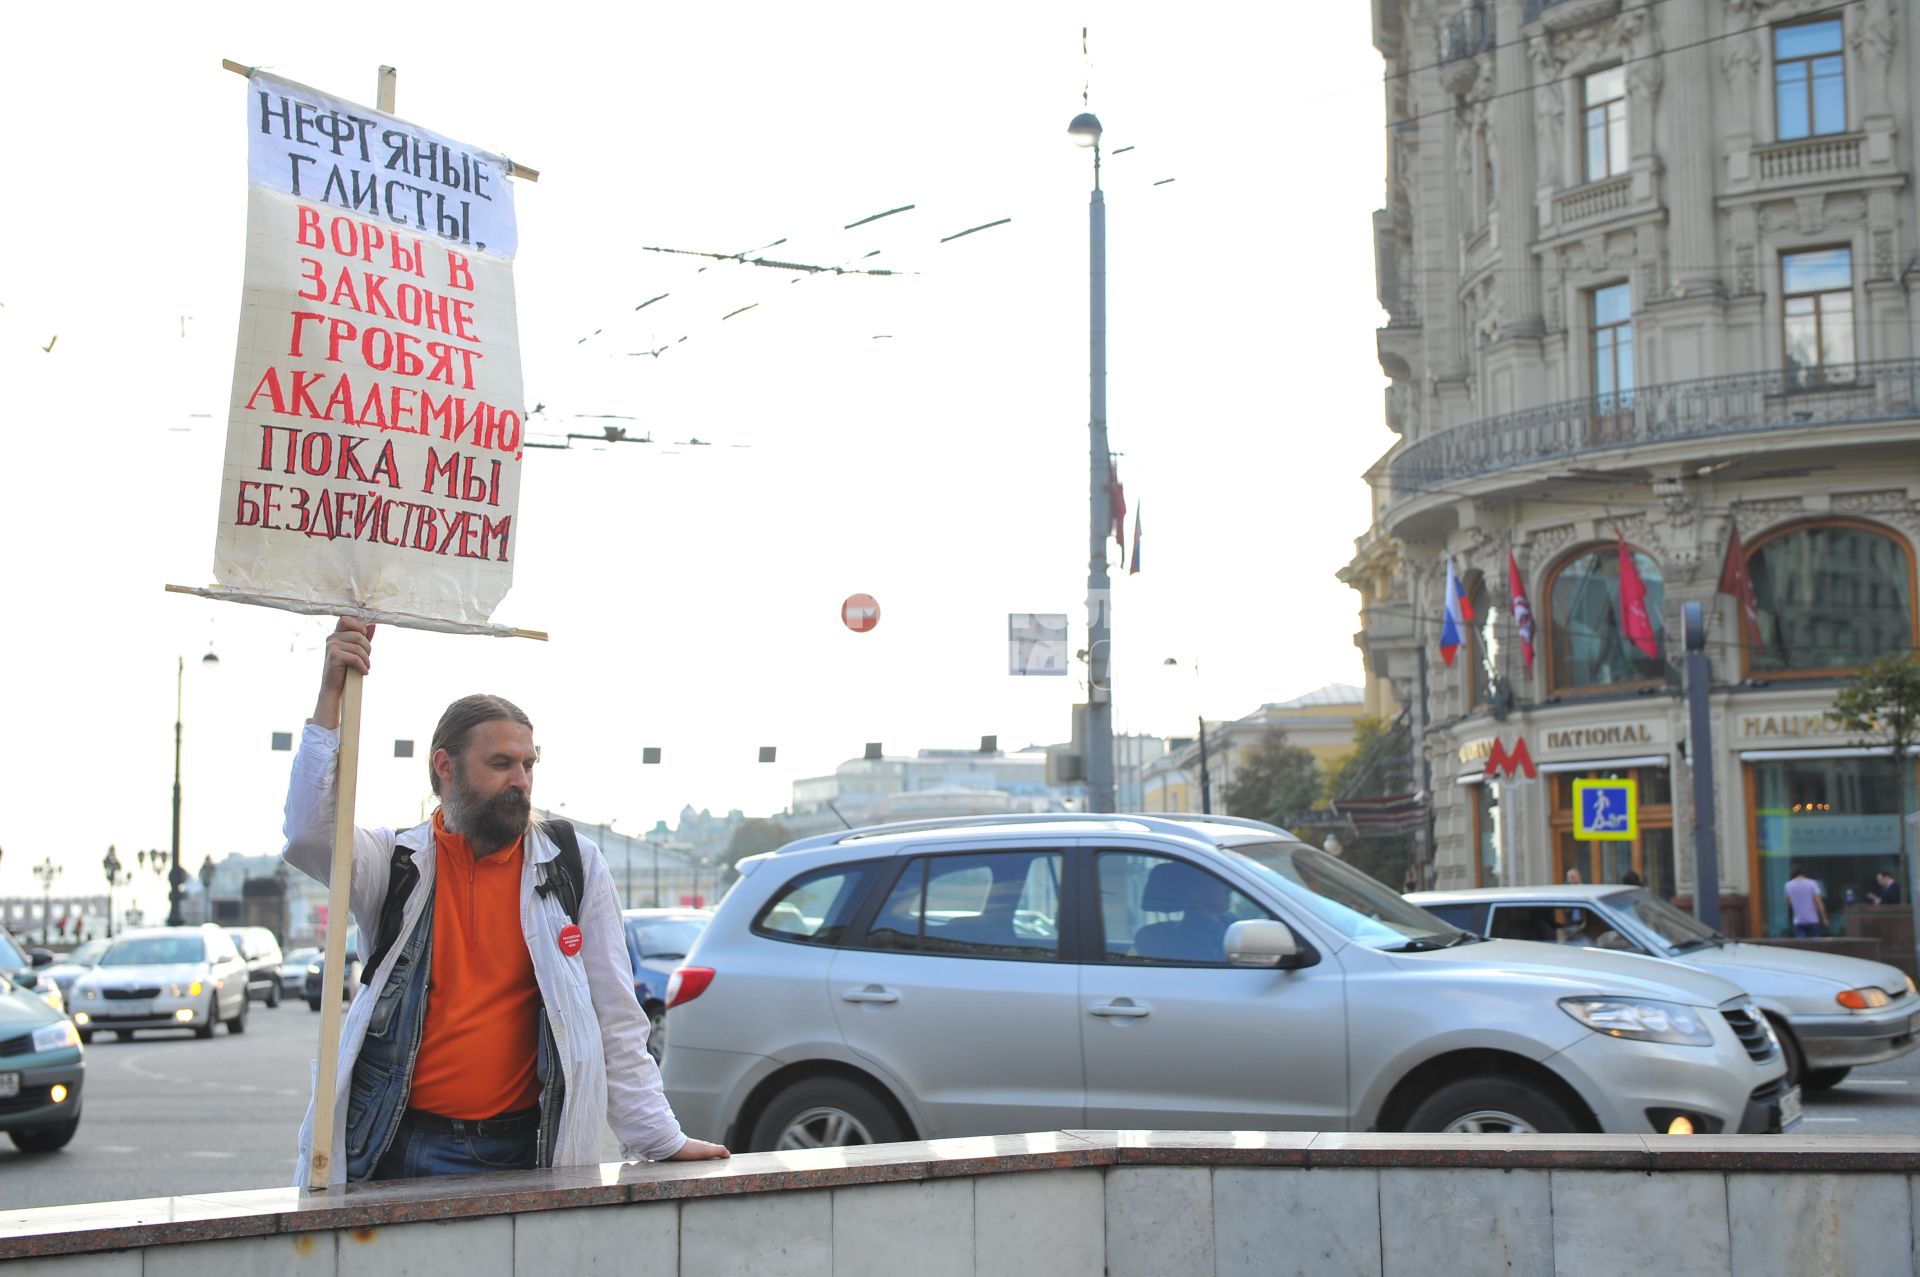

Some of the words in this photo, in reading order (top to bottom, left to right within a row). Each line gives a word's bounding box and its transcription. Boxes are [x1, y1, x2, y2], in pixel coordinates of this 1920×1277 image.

[258, 91, 493, 202] НЕФТЯНЫЕ
[296, 204, 426, 279] ВОРЫ
[447, 249, 475, 292] В
[297, 257, 481, 344] ЗАКОНЕ
[287, 311, 484, 390] ГРОБЯТ
[244, 366, 524, 462] АКАДЕМИЮ,
[257, 424, 403, 490] ПОКА
[421, 446, 503, 507] МЫ
[234, 479, 513, 562] БЕЗДЕЙСТВУЕМ
[1547, 723, 1652, 749] NATIONAL
